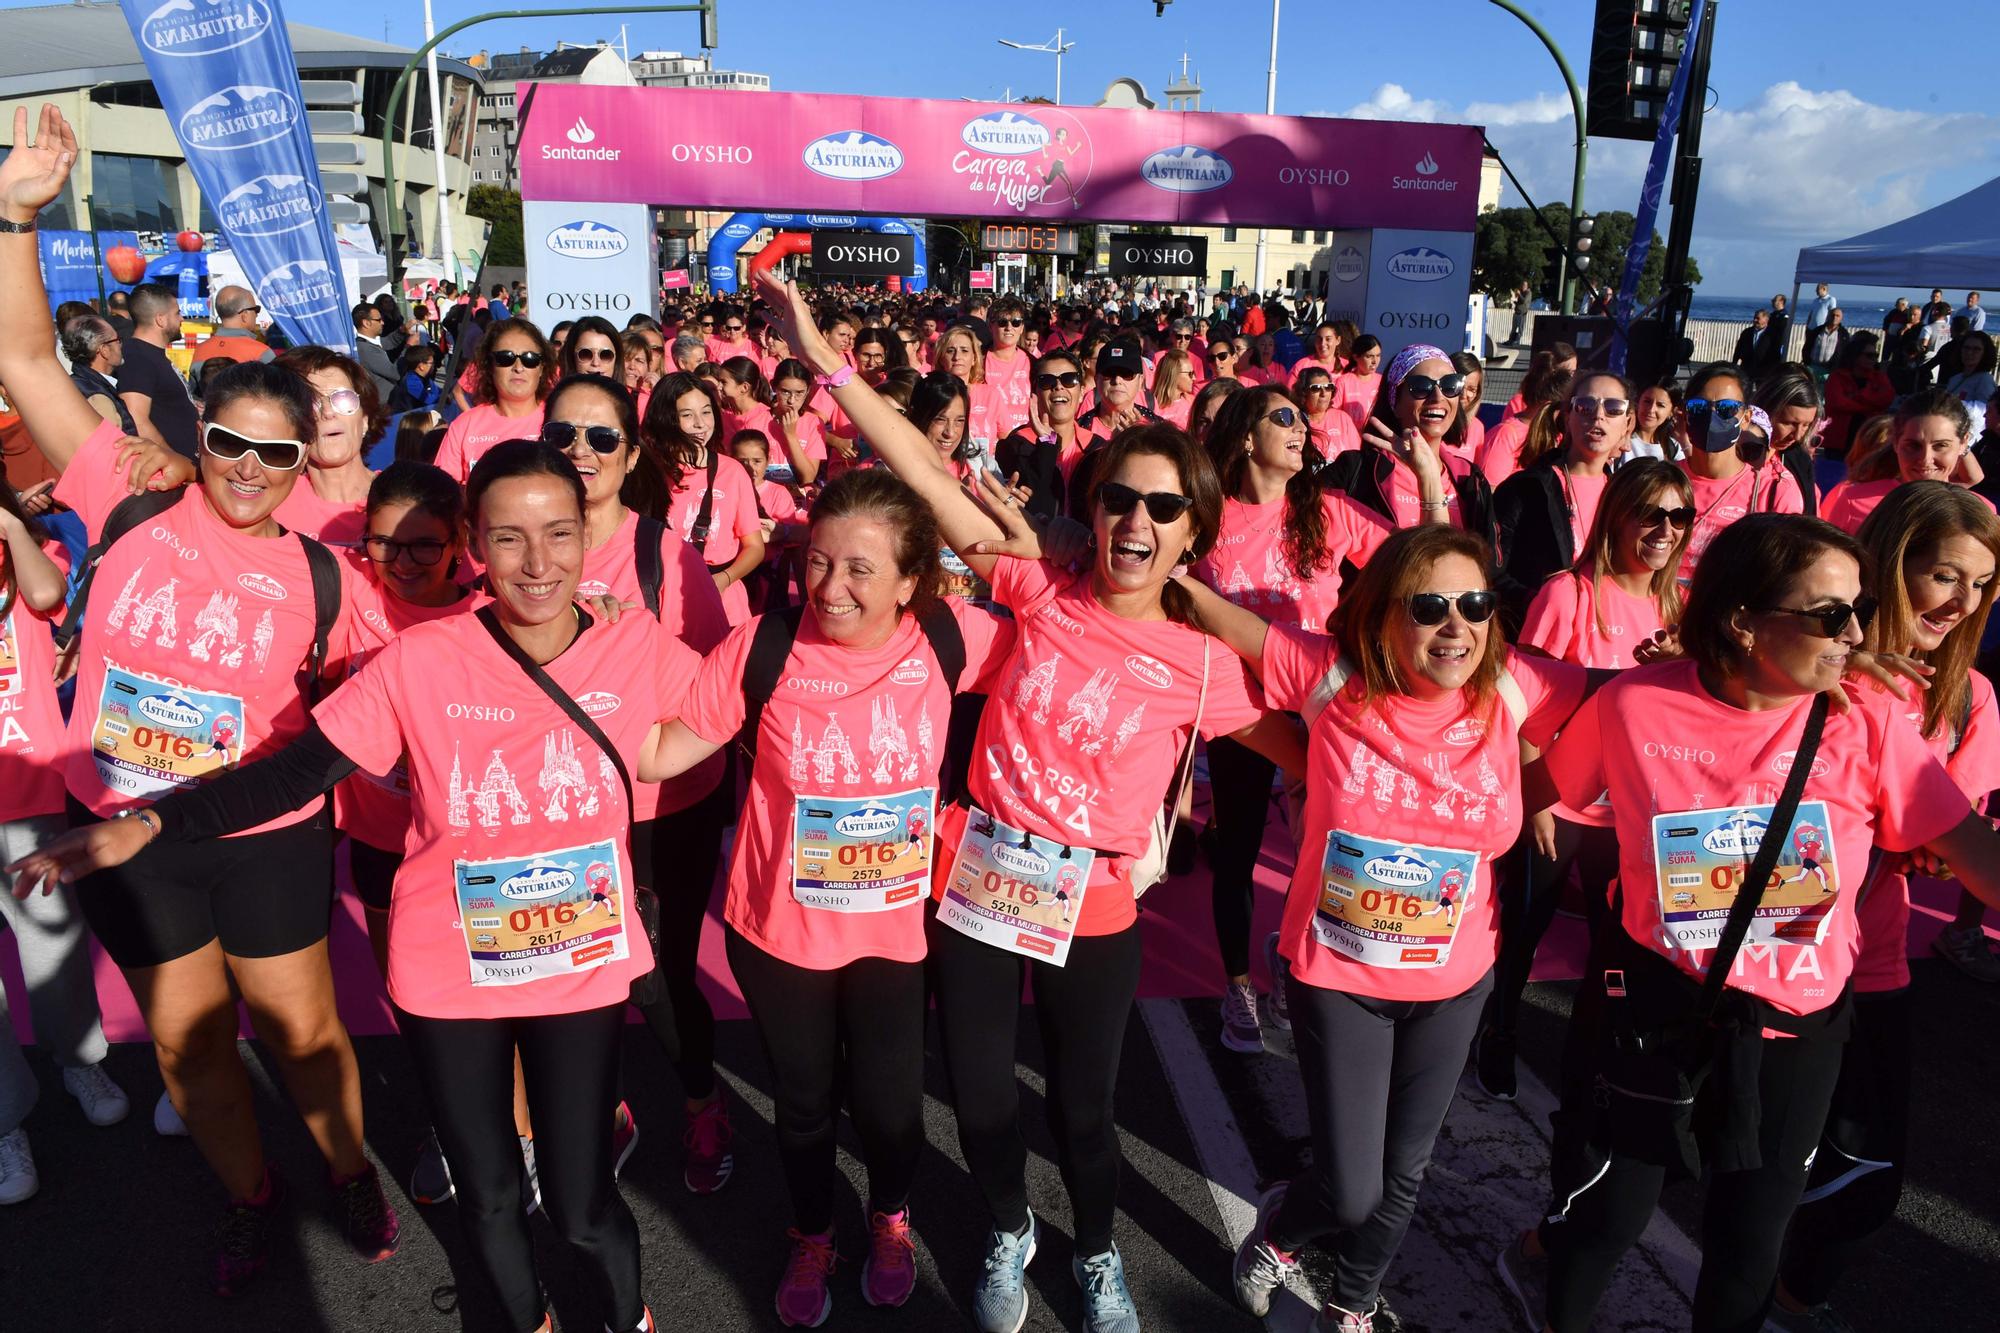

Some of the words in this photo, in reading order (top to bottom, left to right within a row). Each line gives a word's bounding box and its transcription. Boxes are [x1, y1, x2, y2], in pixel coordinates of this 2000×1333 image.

[968, 126, 1044, 145] ASTURIANA
[542, 145, 622, 161] Santander
[671, 144, 753, 164] OYSHO
[811, 148, 896, 168] ASTURIANA
[952, 150, 1026, 175] Carrera
[1148, 159, 1227, 182] ASTURIANA
[1279, 166, 1350, 186] OYSHO
[970, 176, 985, 191] de
[986, 176, 996, 192] la
[994, 174, 1053, 212] Mujer
[1392, 176, 1458, 192] Santander
[810, 214, 853, 224] ASTURIANA
[552, 234, 623, 250] ASTURIANA
[986, 225, 1072, 250] 00:06:31
[52, 239, 101, 264] Marlen
[827, 245, 900, 264] OYSHO
[1125, 247, 1194, 265] OYSHO
[1391, 258, 1450, 274] ASTURIANA
[546, 292, 631, 312] OYSHO
[1379, 310, 1450, 330] OYSHO
[241, 576, 283, 599] ASTURIANA
[1128, 658, 1170, 686] ASTURIANA
[788, 677, 848, 696] OYSHO
[142, 700, 199, 726] ASTURIANA
[446, 702, 516, 722] OYSHO
[582, 700, 618, 712] TURIANA
[133, 726, 194, 759] 016
[143, 754, 174, 770] 3351
[1644, 742, 1716, 765] OYSHO
[100, 767, 137, 789] OYSHO
[114, 758, 147, 775] CARRERA
[148, 769, 159, 778] DE
[160, 772, 170, 780] LA
[172, 774, 200, 785] MUJER
[1012, 743, 1100, 806] DORSAL
[1002, 795, 1012, 806] DE
[1014, 803, 1023, 812] LA
[840, 819, 896, 832] ASTURIANA
[838, 842, 896, 866] 016
[992, 846, 1046, 873] ASTURIANA
[1668, 856, 1696, 865] SUMA
[852, 868, 882, 880] 2579
[1331, 866, 1354, 880] SUMA
[1368, 862, 1428, 882] ASTURIANA
[506, 877, 572, 896] ASTURIANA
[824, 880, 858, 889] CARRERA
[860, 880, 870, 888] DE
[871, 880, 880, 888] LA
[882, 876, 906, 886] MUJER
[984, 870, 1040, 905] 016
[806, 894, 850, 906] OYSHO
[991, 900, 1020, 916] 5210
[1360, 889, 1422, 918] 016
[509, 902, 576, 933] 016
[948, 906, 984, 932] OYSHO
[964, 900, 994, 919] CARRERA
[996, 912, 1005, 922] DE
[1006, 916, 1016, 926] LA
[1017, 920, 1042, 934] MUJER
[1754, 908, 1766, 916] LA
[1770, 908, 1800, 916] MUJER
[1340, 921, 1375, 939] CARRERA
[1376, 932, 1387, 941] DE
[1388, 934, 1399, 942] LA
[1400, 936, 1426, 944] MUJER
[1371, 918, 1403, 932] 3048
[500, 948, 538, 960] CARRERA
[540, 946, 550, 954] DE
[553, 944, 564, 952] LA
[565, 934, 592, 948] MUJER
[528, 930, 562, 946] 2617
[1323, 927, 1364, 953] OYSHO
[484, 964, 532, 977] OYSHO
[1803, 988, 1825, 996] 2022
